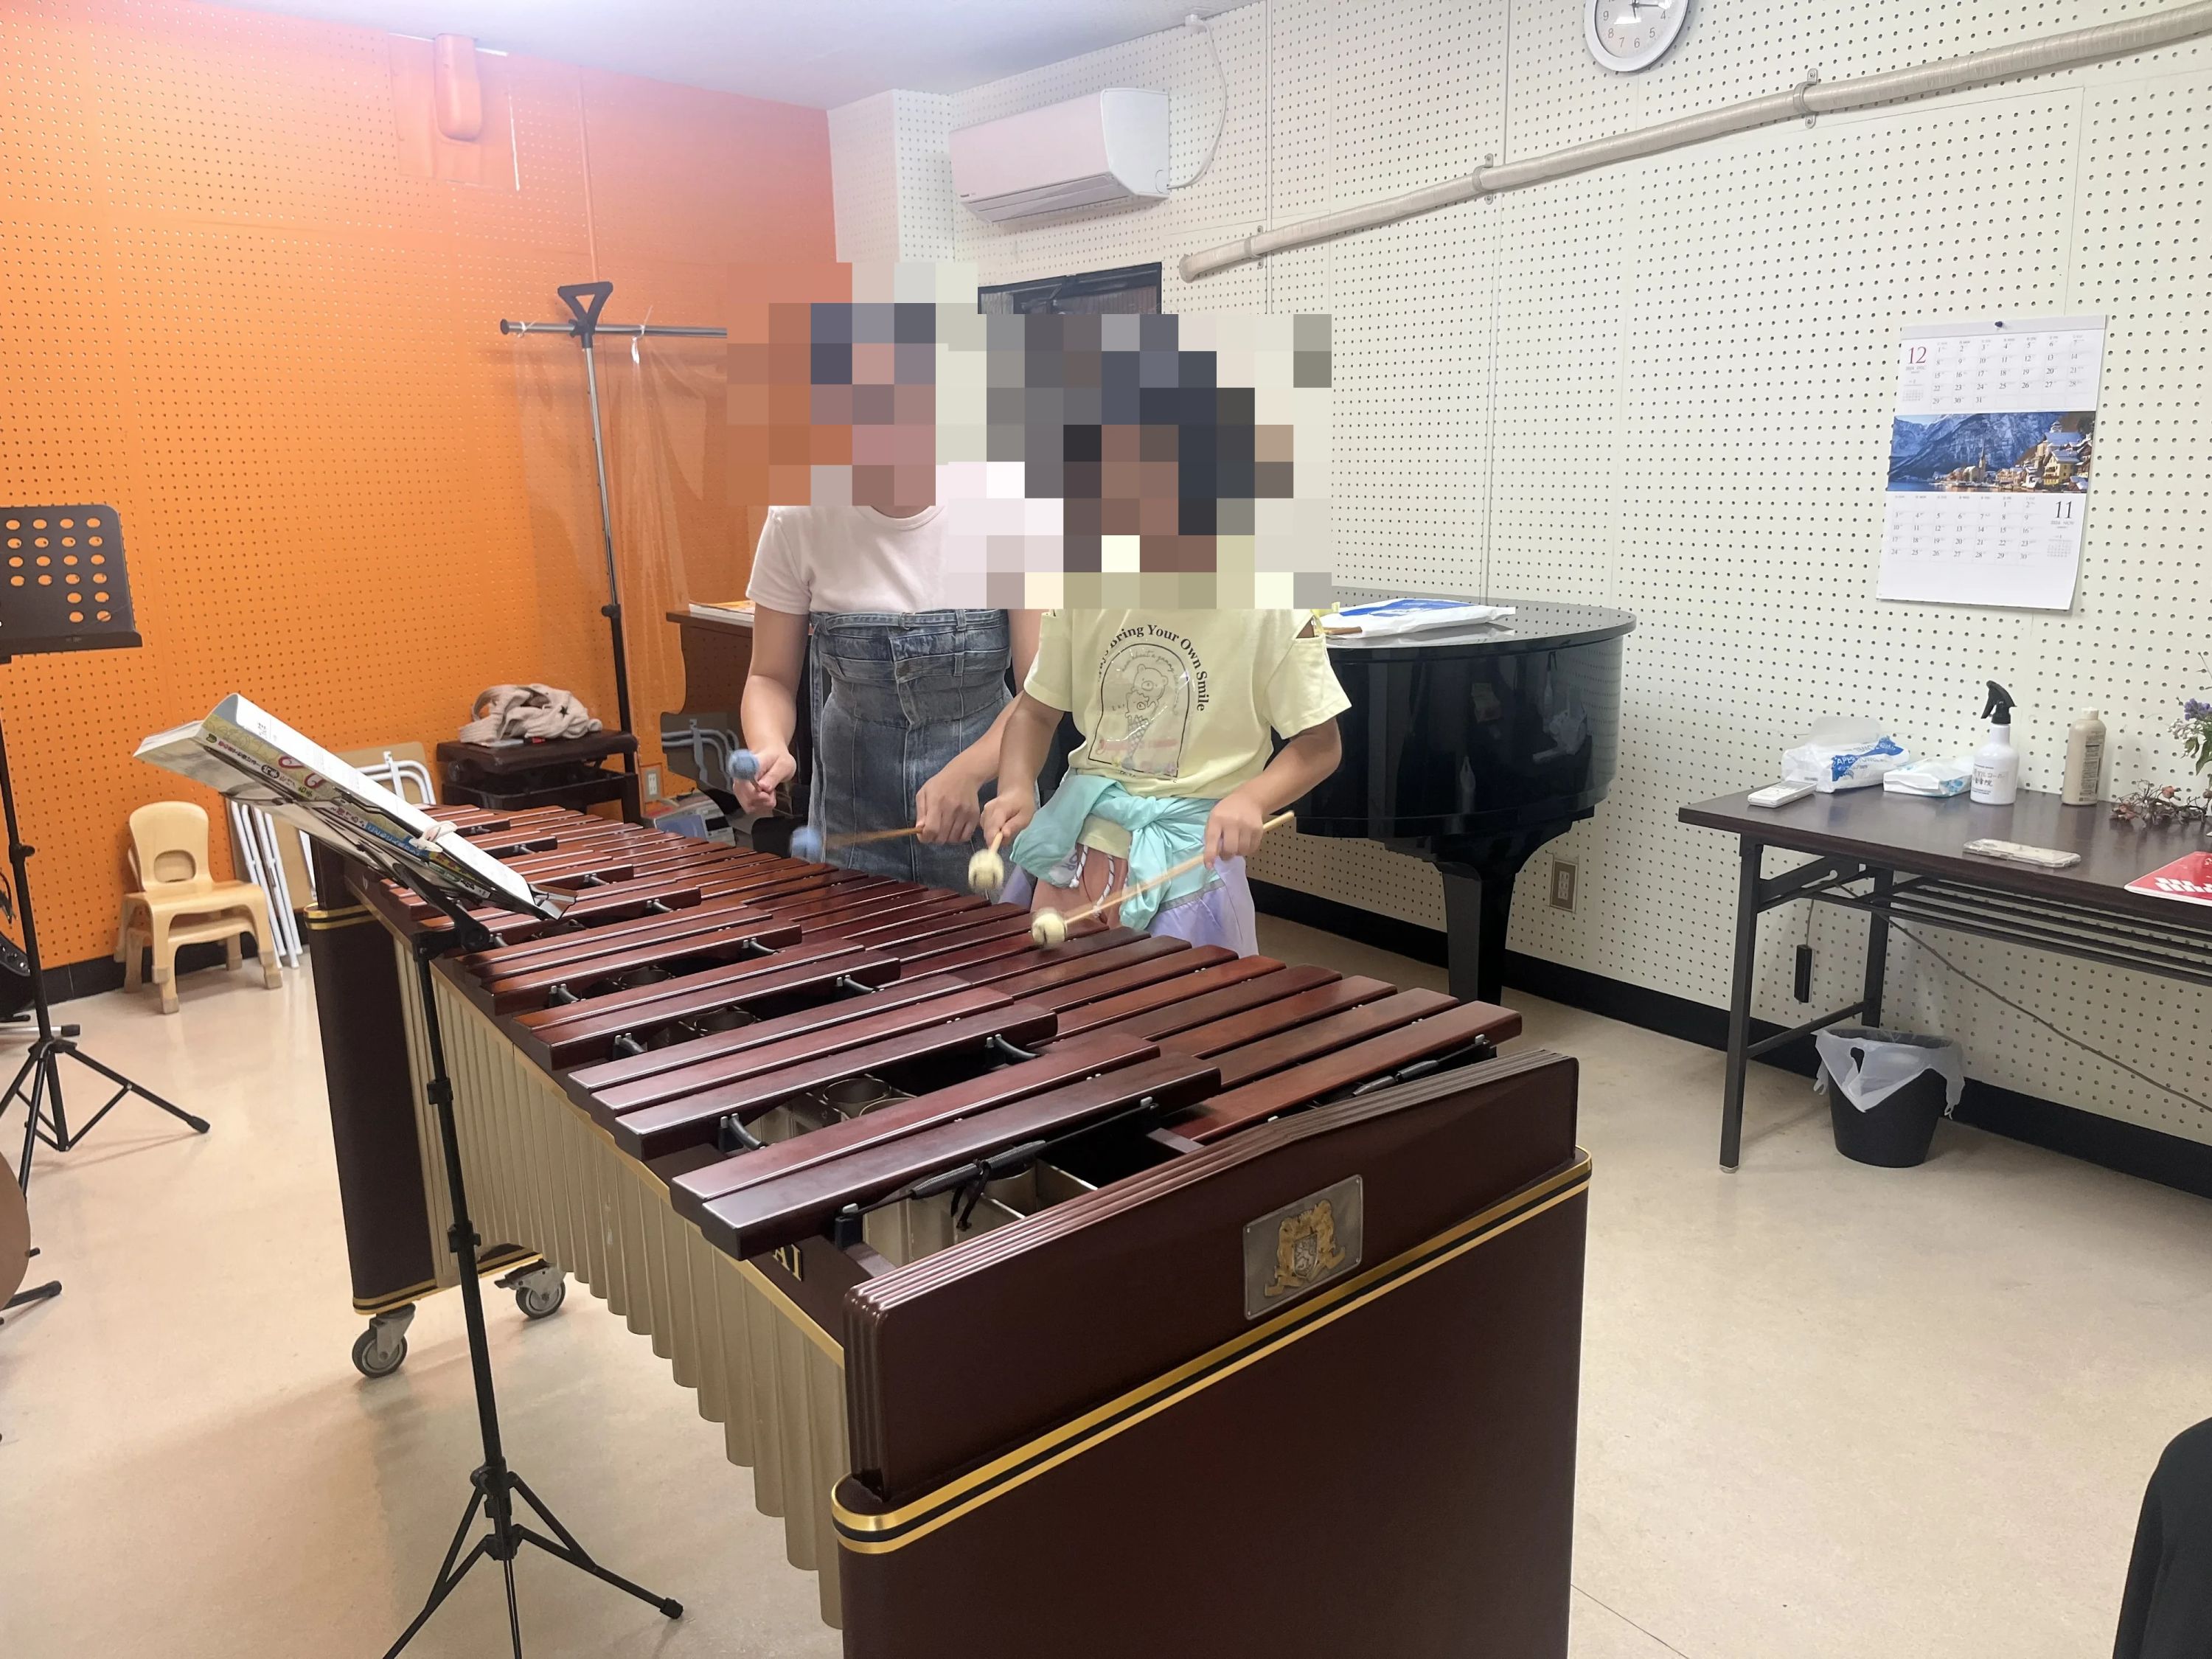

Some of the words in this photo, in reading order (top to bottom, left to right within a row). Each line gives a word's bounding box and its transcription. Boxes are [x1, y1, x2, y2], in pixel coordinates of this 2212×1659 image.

[1603, 11, 1609, 21] 9
[1660, 11, 1666, 20] 4
[1608, 28, 1613, 38] 8
[1649, 27, 1655, 38] 5
[1619, 37, 1624, 47] 7
[1634, 38, 1640, 48] 6
[1908, 346, 1927, 364] 12
[2056, 501, 2072, 518] 11
[1147, 624, 1180, 641] Your
[1180, 639, 1201, 669] Own
[1196, 671, 1209, 712] Smile
